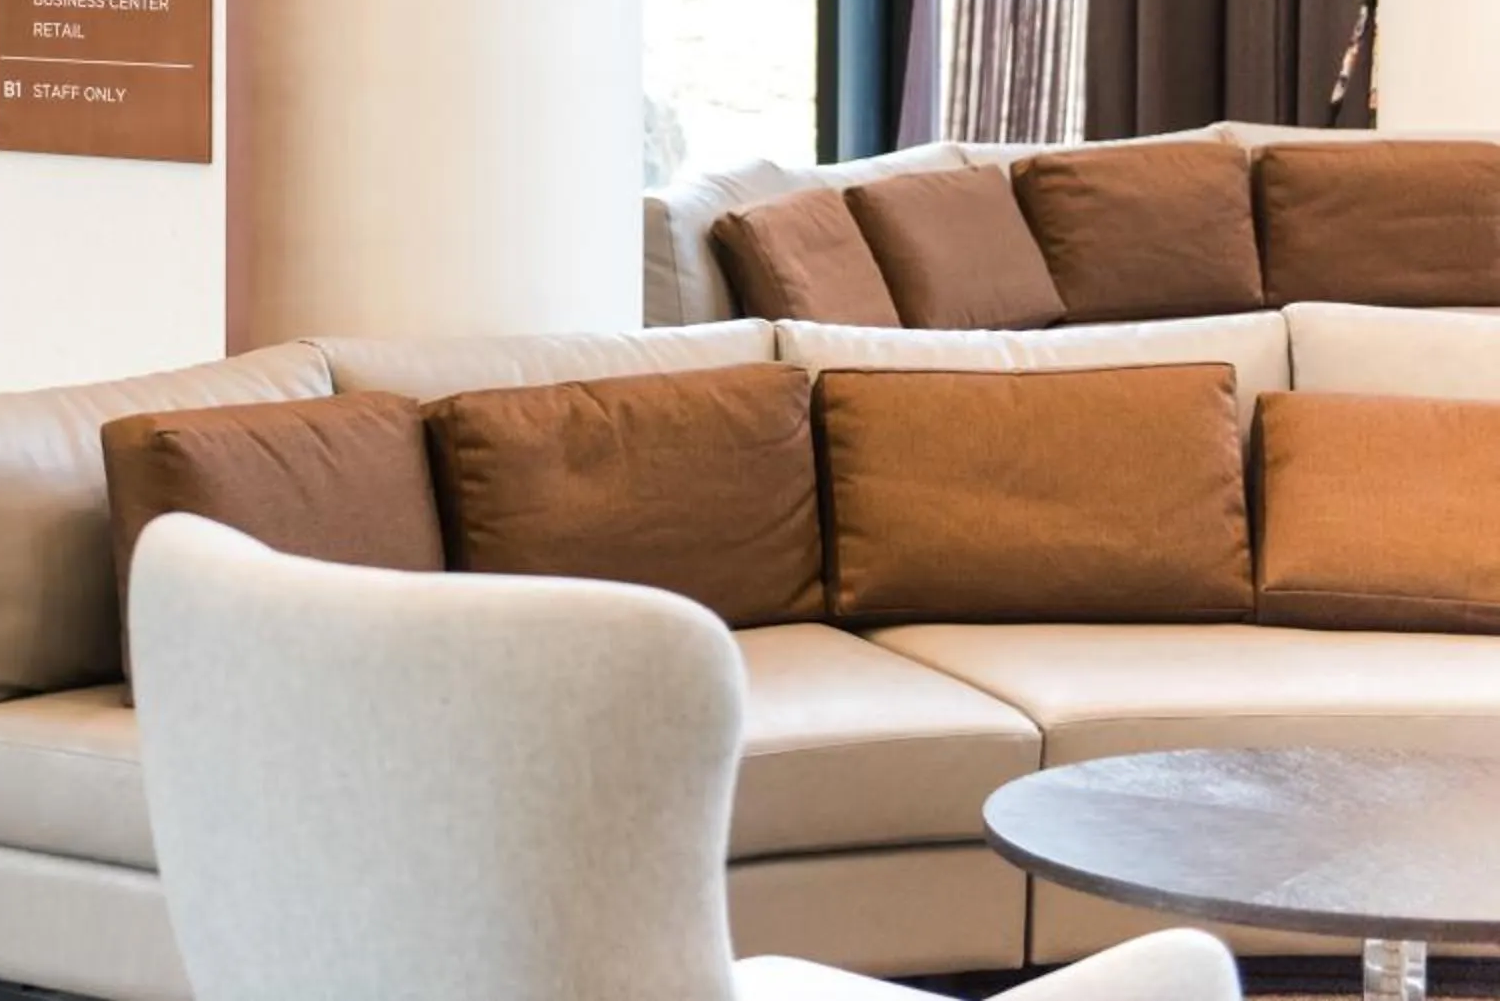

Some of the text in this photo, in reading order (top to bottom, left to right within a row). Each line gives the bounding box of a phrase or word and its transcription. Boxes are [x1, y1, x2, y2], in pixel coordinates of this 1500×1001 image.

[33, 21, 85, 39] RETAIL
[3, 80, 127, 103] B1 STAFF ONLY
